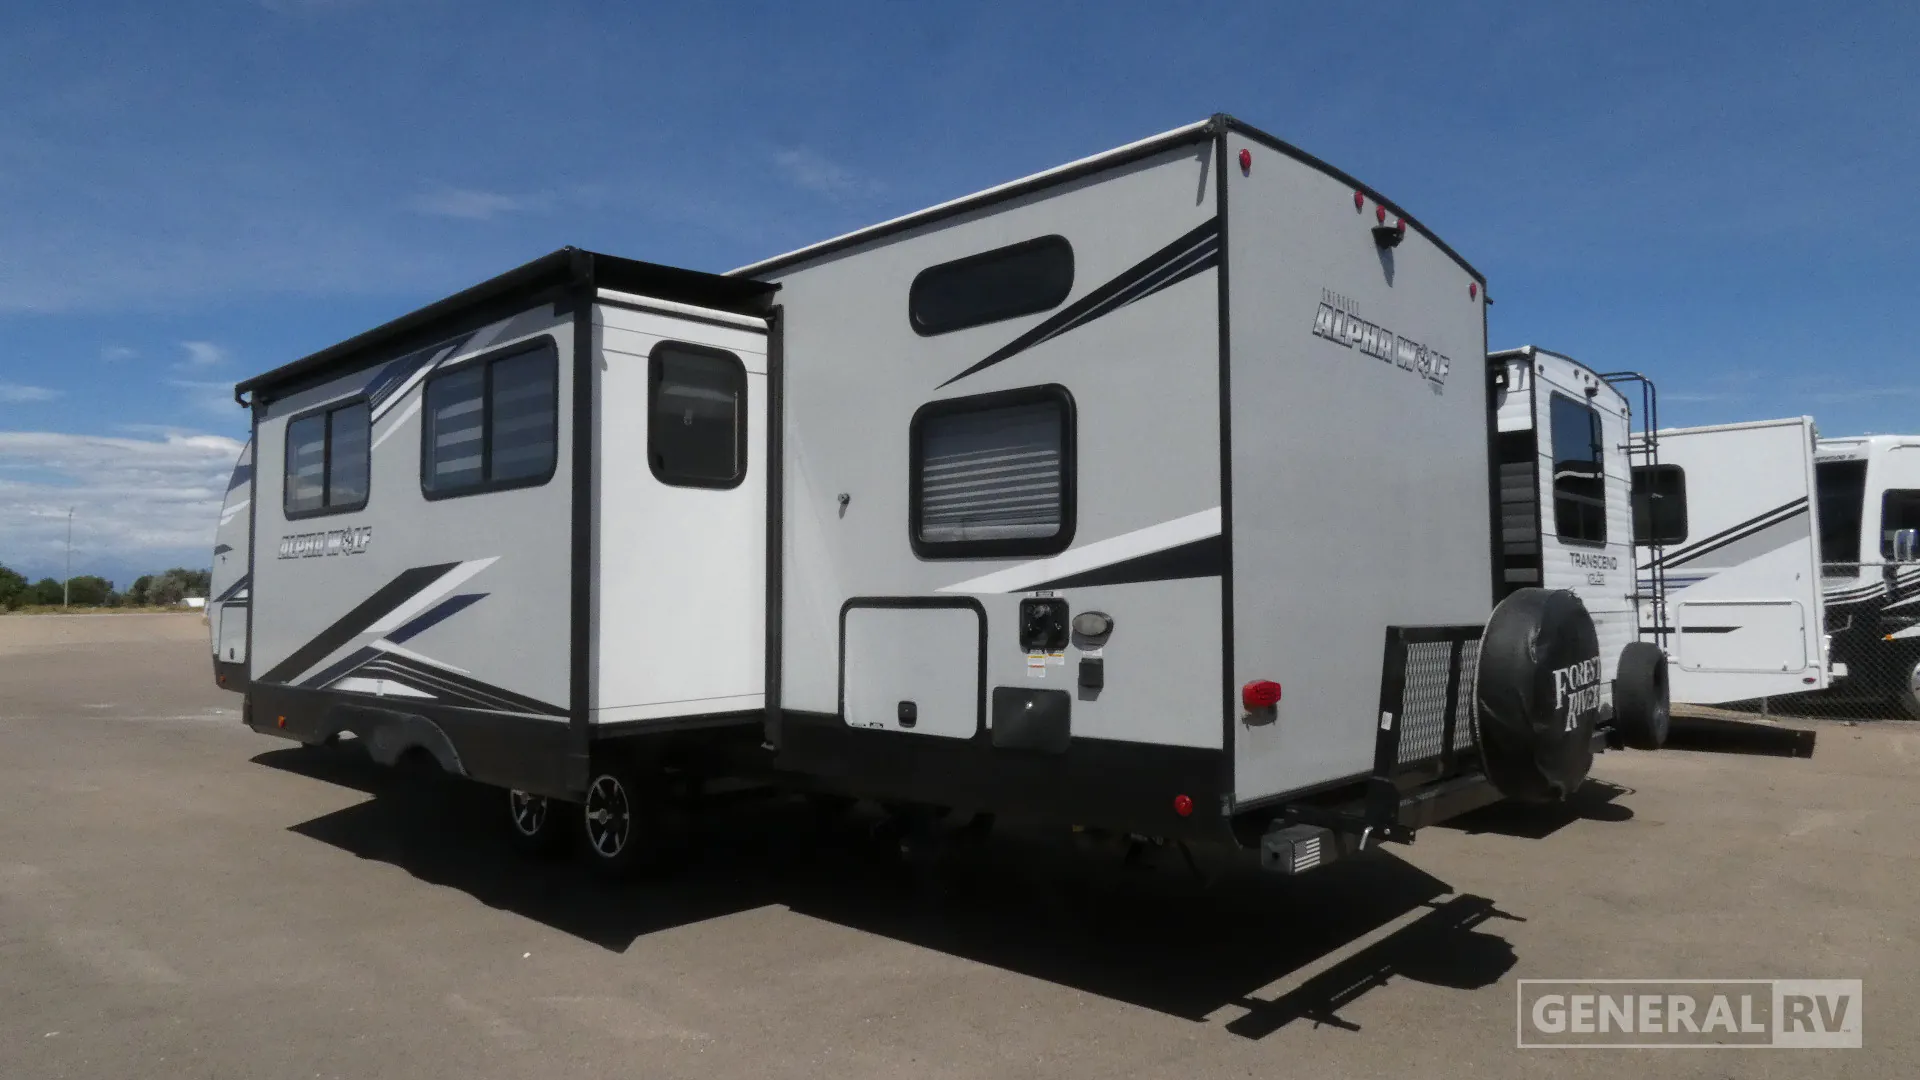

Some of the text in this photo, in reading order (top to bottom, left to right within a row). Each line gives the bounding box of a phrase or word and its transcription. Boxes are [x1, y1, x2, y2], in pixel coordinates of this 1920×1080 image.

[1312, 301, 1393, 364] ALPHA
[278, 532, 325, 560] ALPHA
[1569, 552, 1618, 570] TRANSCEND
[1552, 655, 1600, 710] FOREST
